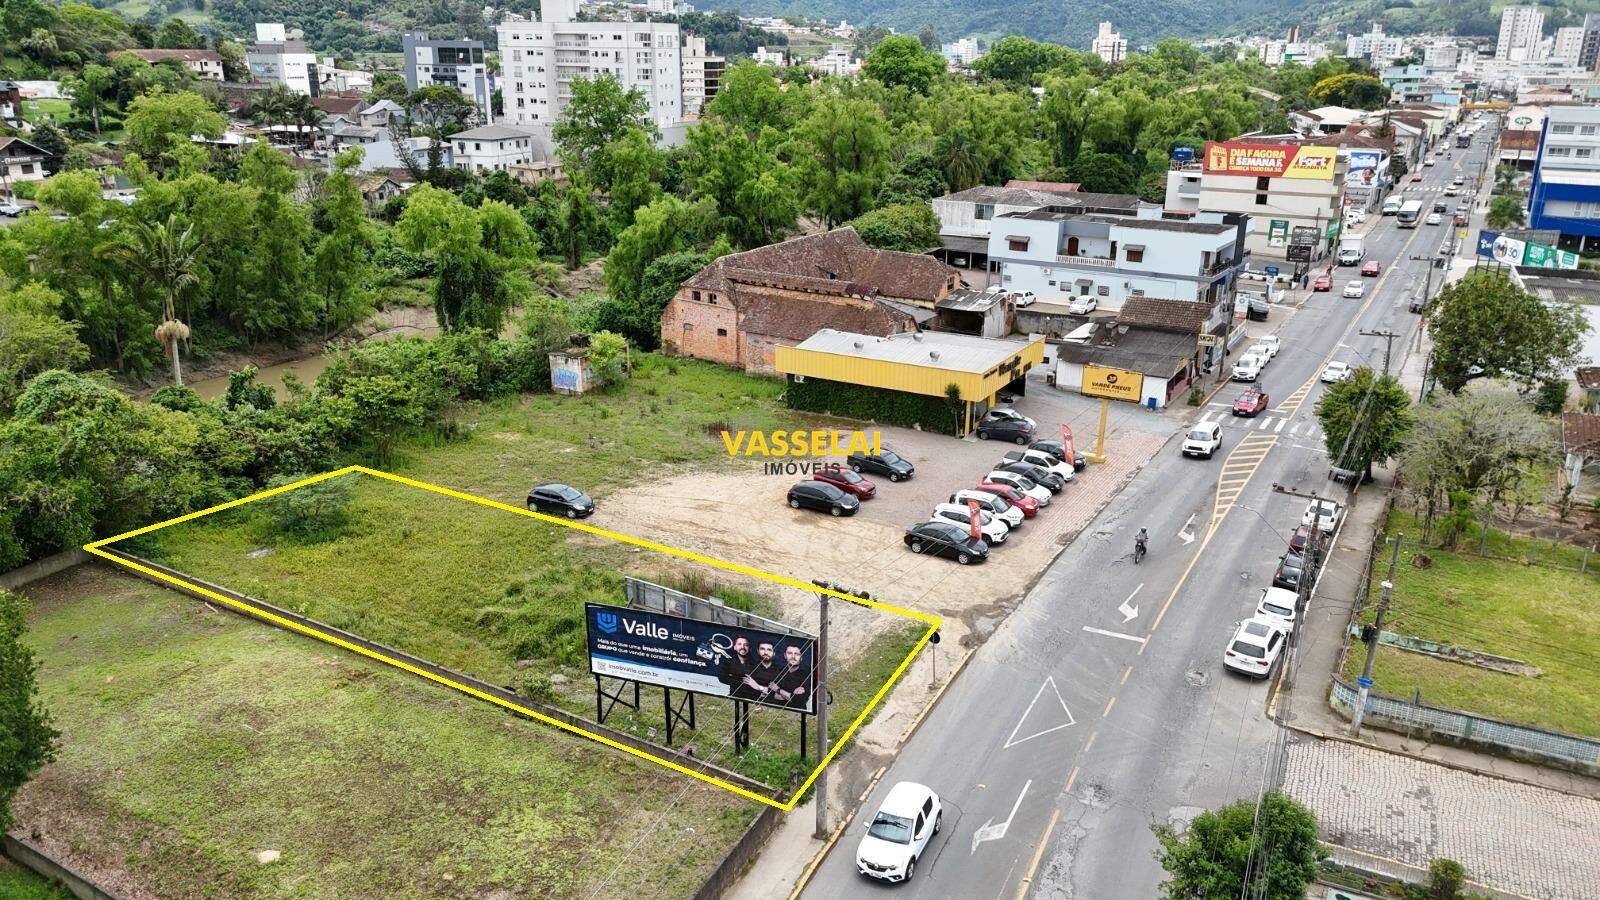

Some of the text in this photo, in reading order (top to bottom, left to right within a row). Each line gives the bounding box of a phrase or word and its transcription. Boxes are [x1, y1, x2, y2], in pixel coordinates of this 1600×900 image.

[1230, 148, 1247, 157] DIA
[1254, 150, 1287, 159] AGORA
[1236, 157, 1275, 167] SEMANA
[1298, 155, 1327, 166] Fort
[622, 618, 669, 640] Valle
[597, 643, 617, 652] GRUPO
[628, 649, 645, 657] vende
